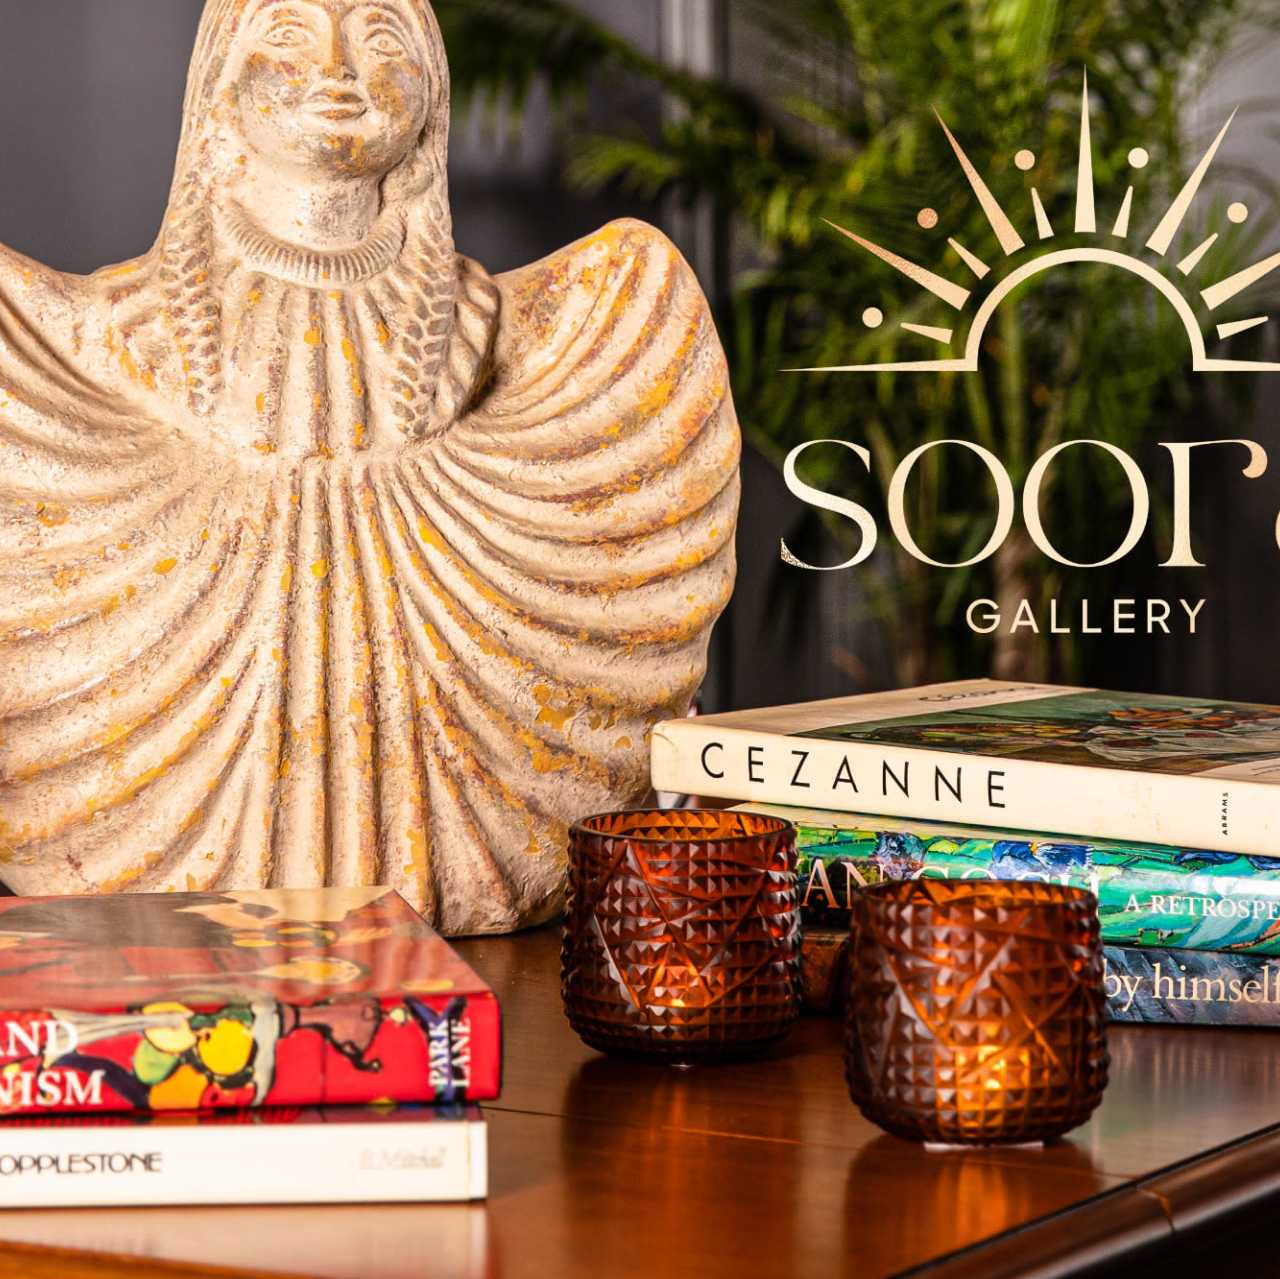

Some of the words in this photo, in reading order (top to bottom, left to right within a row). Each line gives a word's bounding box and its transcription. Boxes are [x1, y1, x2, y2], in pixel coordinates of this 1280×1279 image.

[700, 741, 1007, 809] CEZANNE
[1221, 791, 1229, 836] ABRAMS
[1123, 893, 1142, 914] A
[1103, 957, 1143, 1012] by
[427, 1018, 450, 1088] PARK
[450, 1016, 472, 1089] LANE
